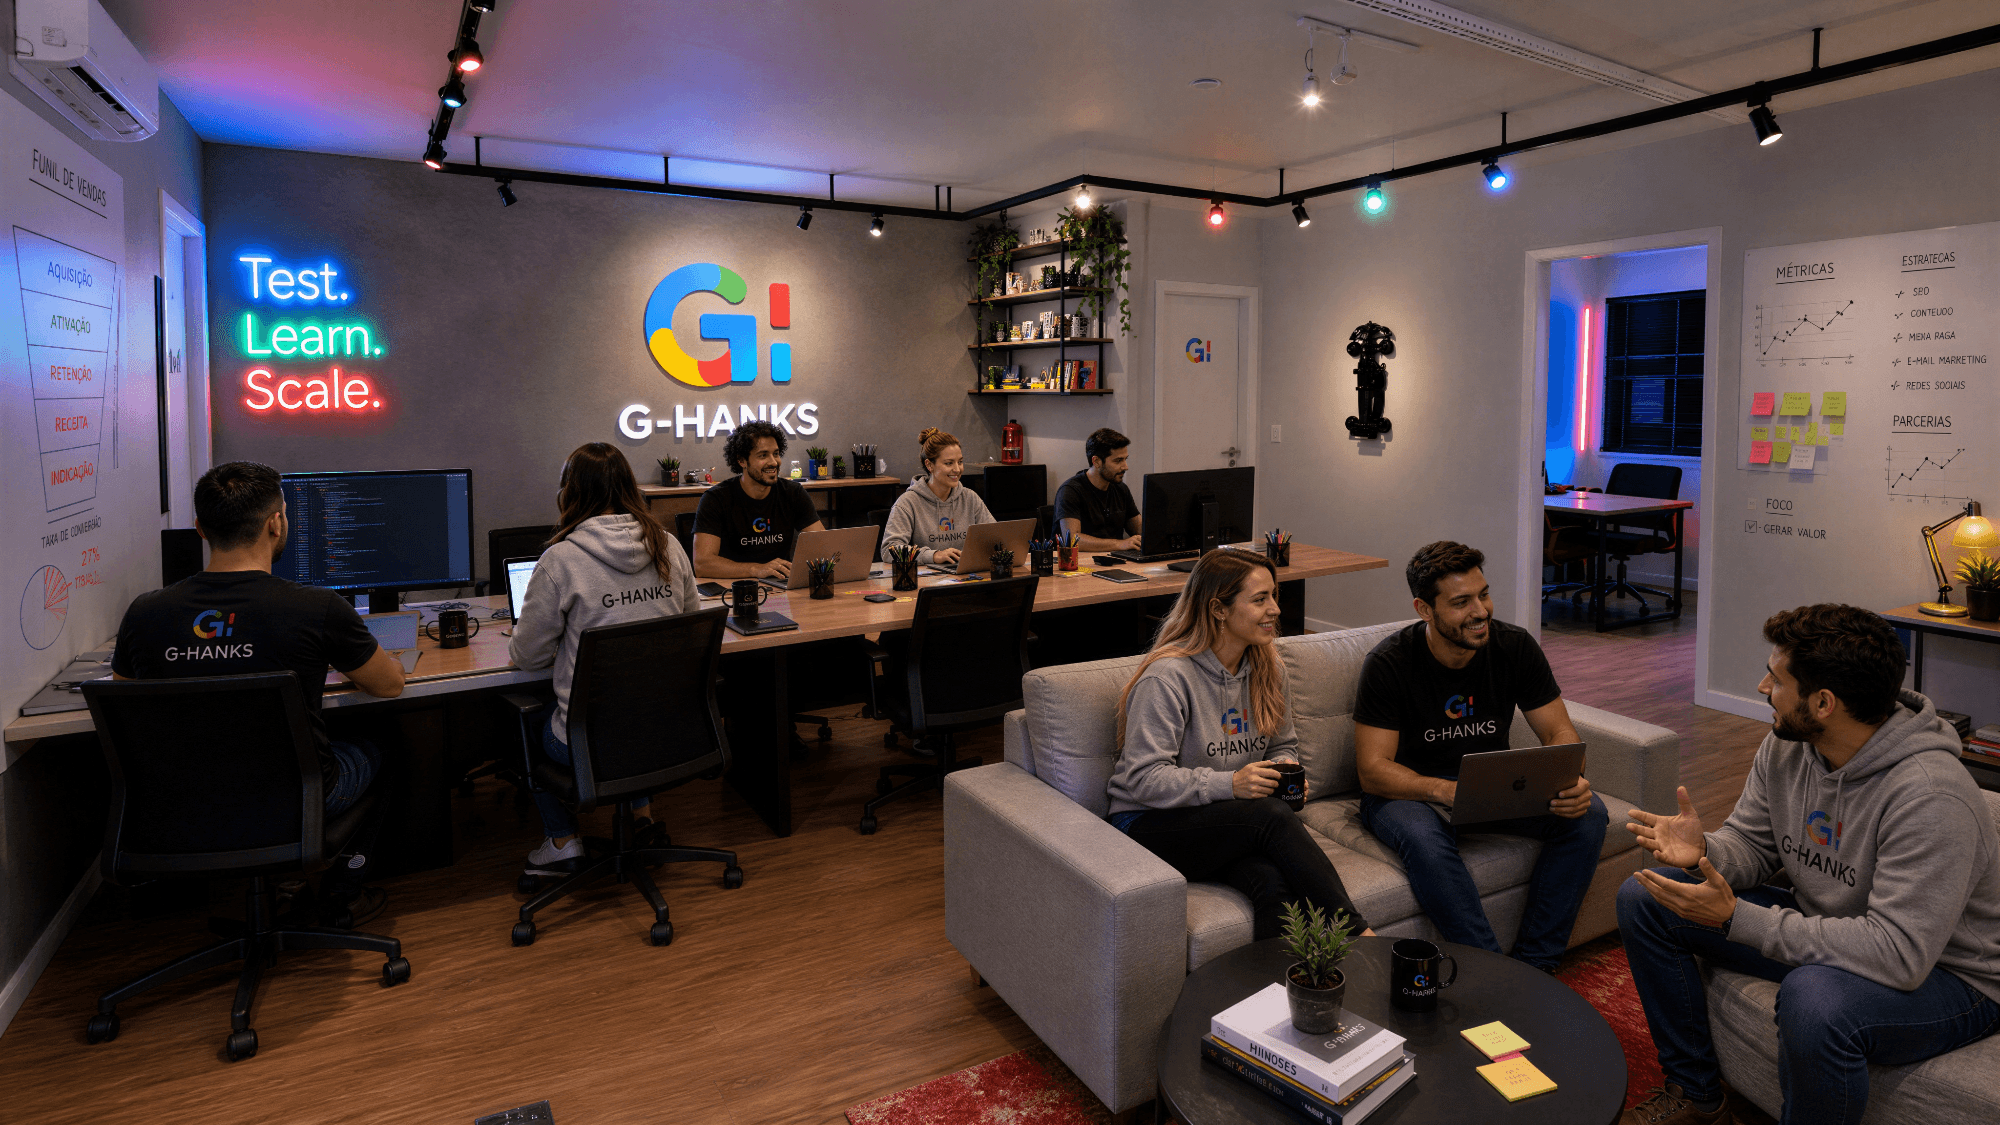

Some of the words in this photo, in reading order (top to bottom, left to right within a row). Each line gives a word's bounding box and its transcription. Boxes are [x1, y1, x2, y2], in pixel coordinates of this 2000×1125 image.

[32, 149, 60, 183] FUNIL
[63, 168, 75, 191] DE
[77, 178, 107, 208] VENDAS
[47, 261, 93, 288] AQUISIÇÃO
[239, 256, 348, 301] Test.
[1776, 262, 1835, 279] MÉTRICAS
[50, 314, 91, 336] ATIVAÇÃO
[246, 313, 382, 356] Learn.
[1938, 354, 1987, 365] MARKETING
[50, 364, 92, 385] RETENÇÃO
[246, 368, 380, 410] Scale.
[618, 402, 820, 440] G-HANKS
[1893, 414, 1952, 429] PARCERIAS
[50, 460, 94, 486] INDICAÇÃO
[1766, 498, 1793, 511] FOCO
[61, 529, 69, 542] DE
[740, 533, 784, 546] G-HANKS
[928, 531, 967, 543] G-HANKS
[1797, 527, 1827, 540] VALOR
[601, 584, 673, 609] G-HANKS
[165, 643, 253, 662] G-HANKS
[1424, 720, 1497, 743] G-HANKS
[1206, 735, 1266, 757] G-HANKS
[1781, 835, 1856, 888] G-HANKS
